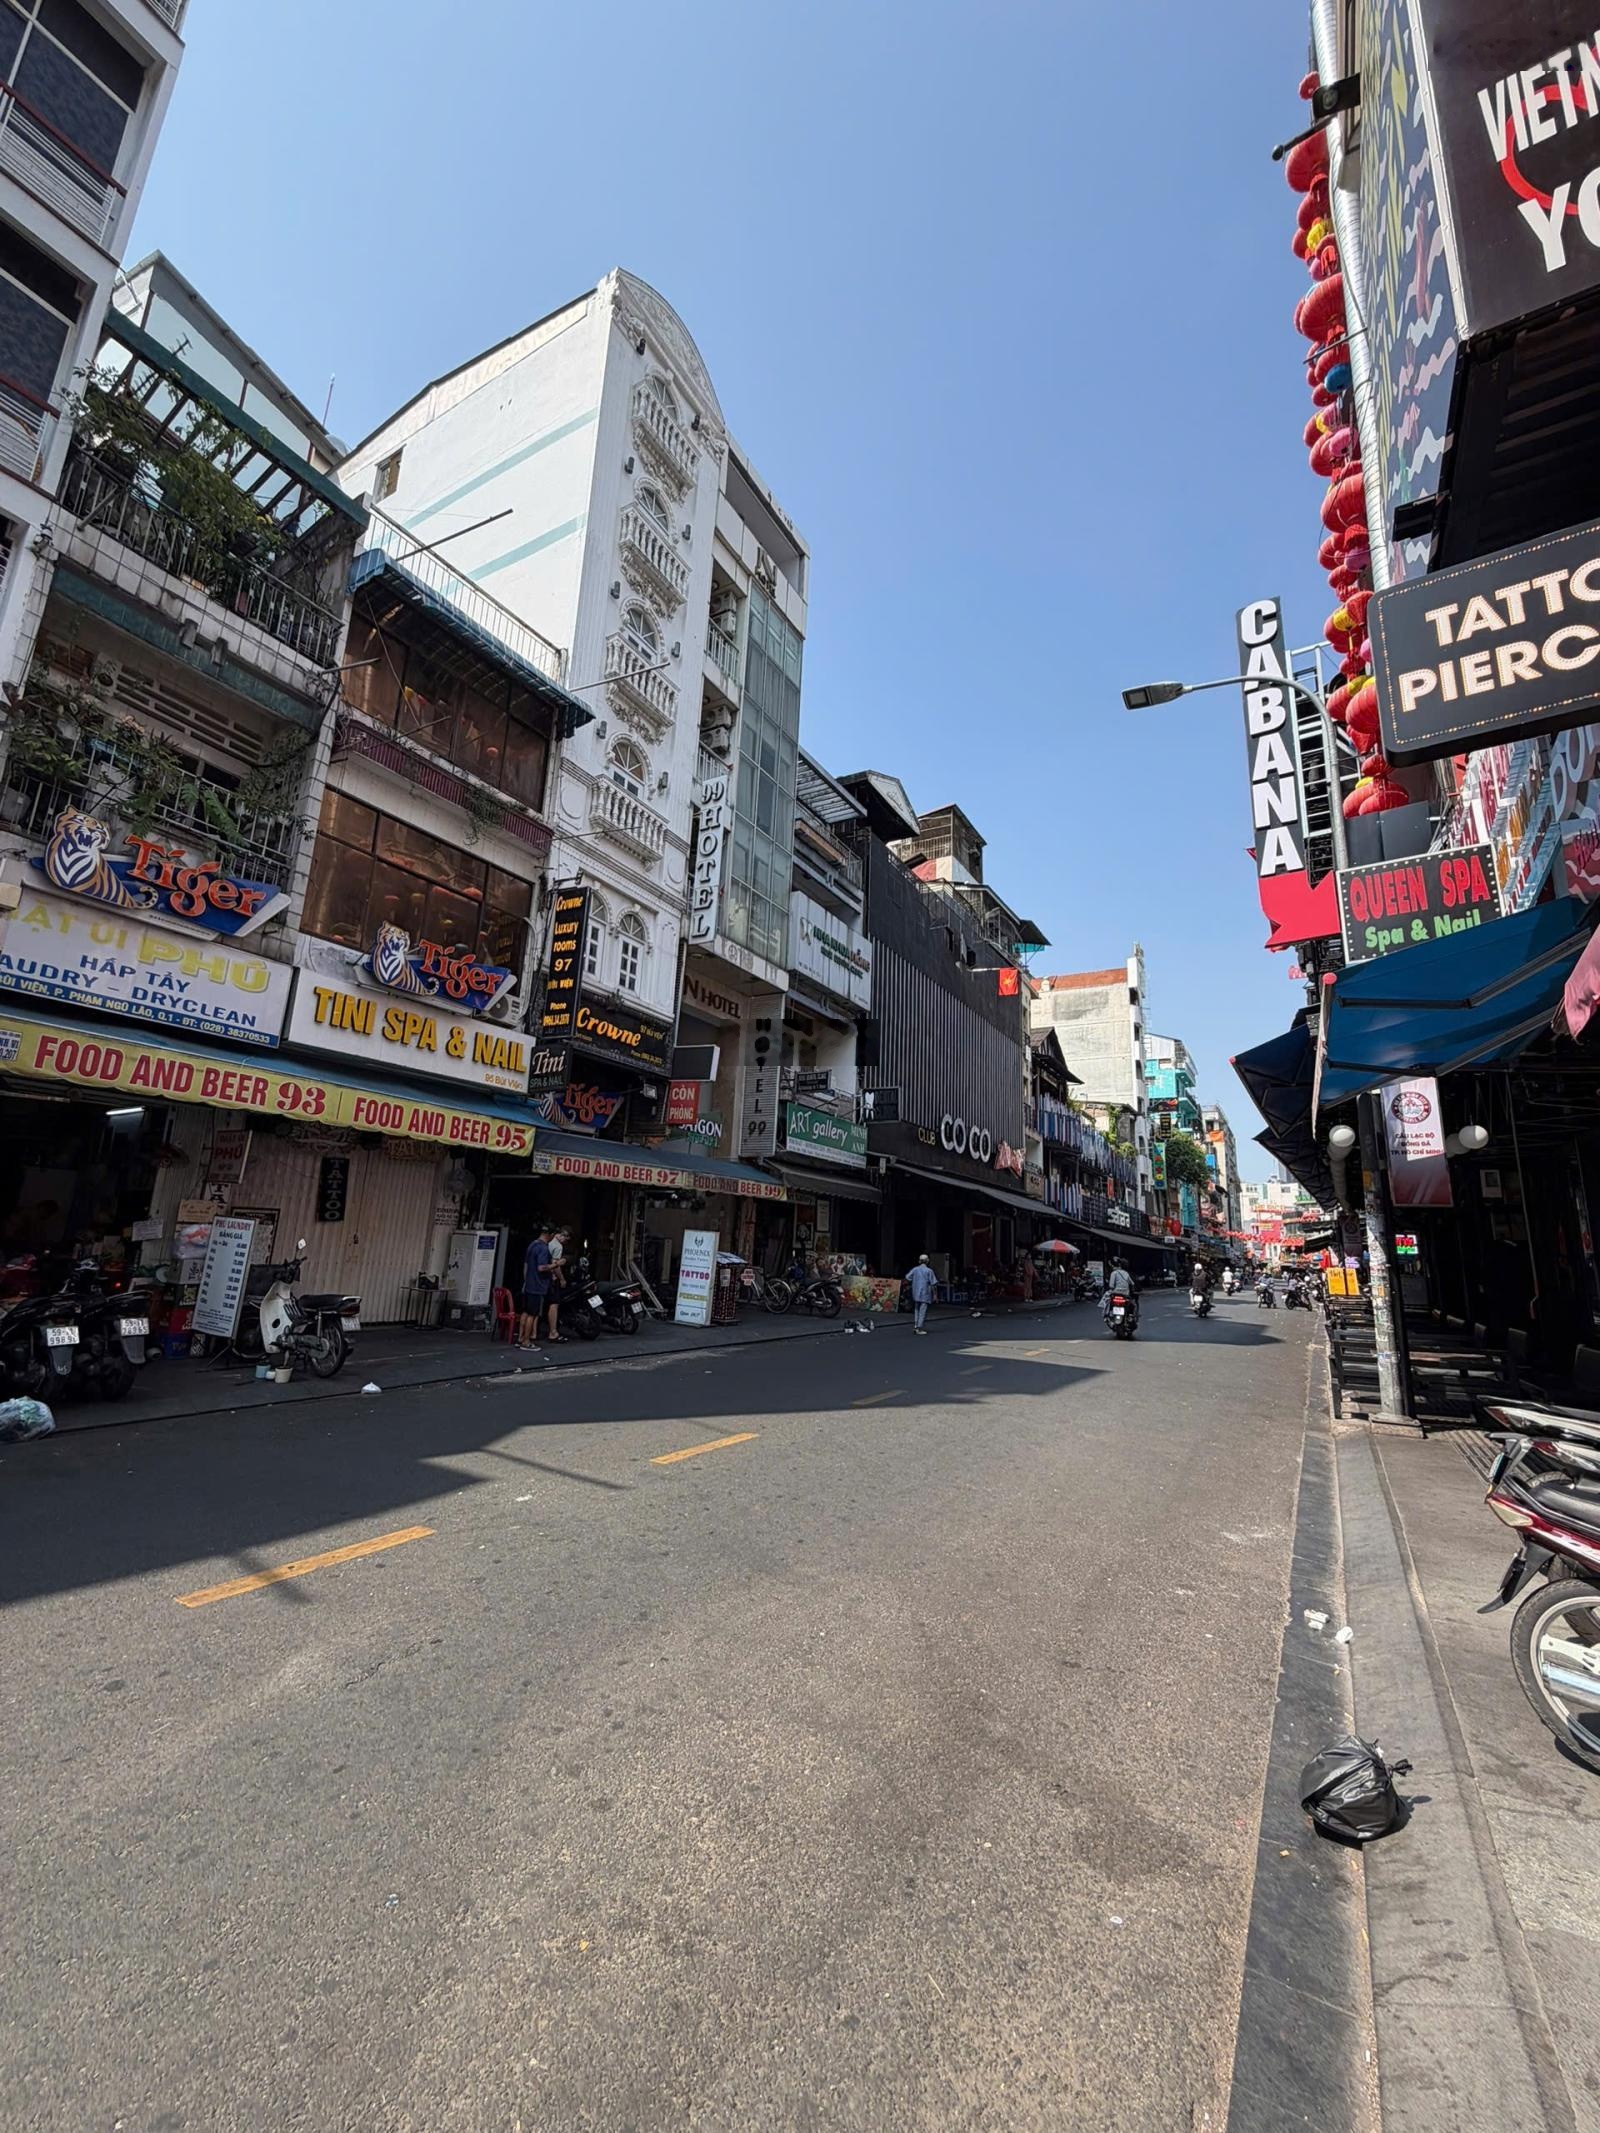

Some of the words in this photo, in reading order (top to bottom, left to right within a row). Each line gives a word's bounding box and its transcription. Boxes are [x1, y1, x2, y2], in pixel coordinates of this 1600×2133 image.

[1398, 624, 1600, 712] PIERC
[1241, 600, 1304, 876] CABANA
[702, 781, 725, 805] 99
[124, 833, 267, 917] Tiger
[692, 806, 722, 939] HOTEL
[1350, 866, 1428, 923] QUEEN
[1440, 855, 1491, 907] SPA
[556, 895, 584, 912] Crowne
[554, 920, 579, 935] Luxury
[1365, 926, 1404, 951] Spa
[1411, 919, 1429, 941] &
[1434, 909, 1481, 937] Nail
[553, 940, 576, 952] rooms
[419, 938, 503, 998] Tiger
[554, 958, 572, 972] 97
[132, 986, 257, 1027] DRYCLEAN
[701, 986, 741, 1019] HOTEL
[200, 1021, 225, 1034] (028)
[314, 987, 377, 1035] TINI
[382, 1007, 437, 1052] SPA
[446, 1026, 467, 1058] &
[473, 1031, 527, 1074] NAIL
[576, 1007, 642, 1048] Crowne
[34, 1034, 124, 1081] FOOD
[129, 1054, 195, 1093] AND
[200, 1066, 269, 1106] BEER
[276, 1081, 327, 1116] 93
[532, 1049, 566, 1075] Tini
[563, 1081, 618, 1123] Tiger
[672, 1086, 695, 1100] CÒN
[352, 1096, 404, 1130] FOOD
[407, 1108, 446, 1136] AND
[450, 1116, 491, 1144] BEER
[496, 1125, 526, 1150] 95
[670, 1104, 694, 1119] PHÒNG
[748, 1121, 766, 1136] 99
[789, 1111, 812, 1135] ART
[812, 1120, 848, 1147] gallery
[918, 1128, 936, 1146] CLUB
[555, 1157, 590, 1174] FOOD
[594, 1162, 620, 1177] AND
[623, 1166, 652, 1182] BEER
[657, 1171, 679, 1185] 97
[325, 1160, 344, 1220] TATTOO
[740, 1182, 762, 1195] BEER
[681, 1270, 710, 1280] TATTOO
